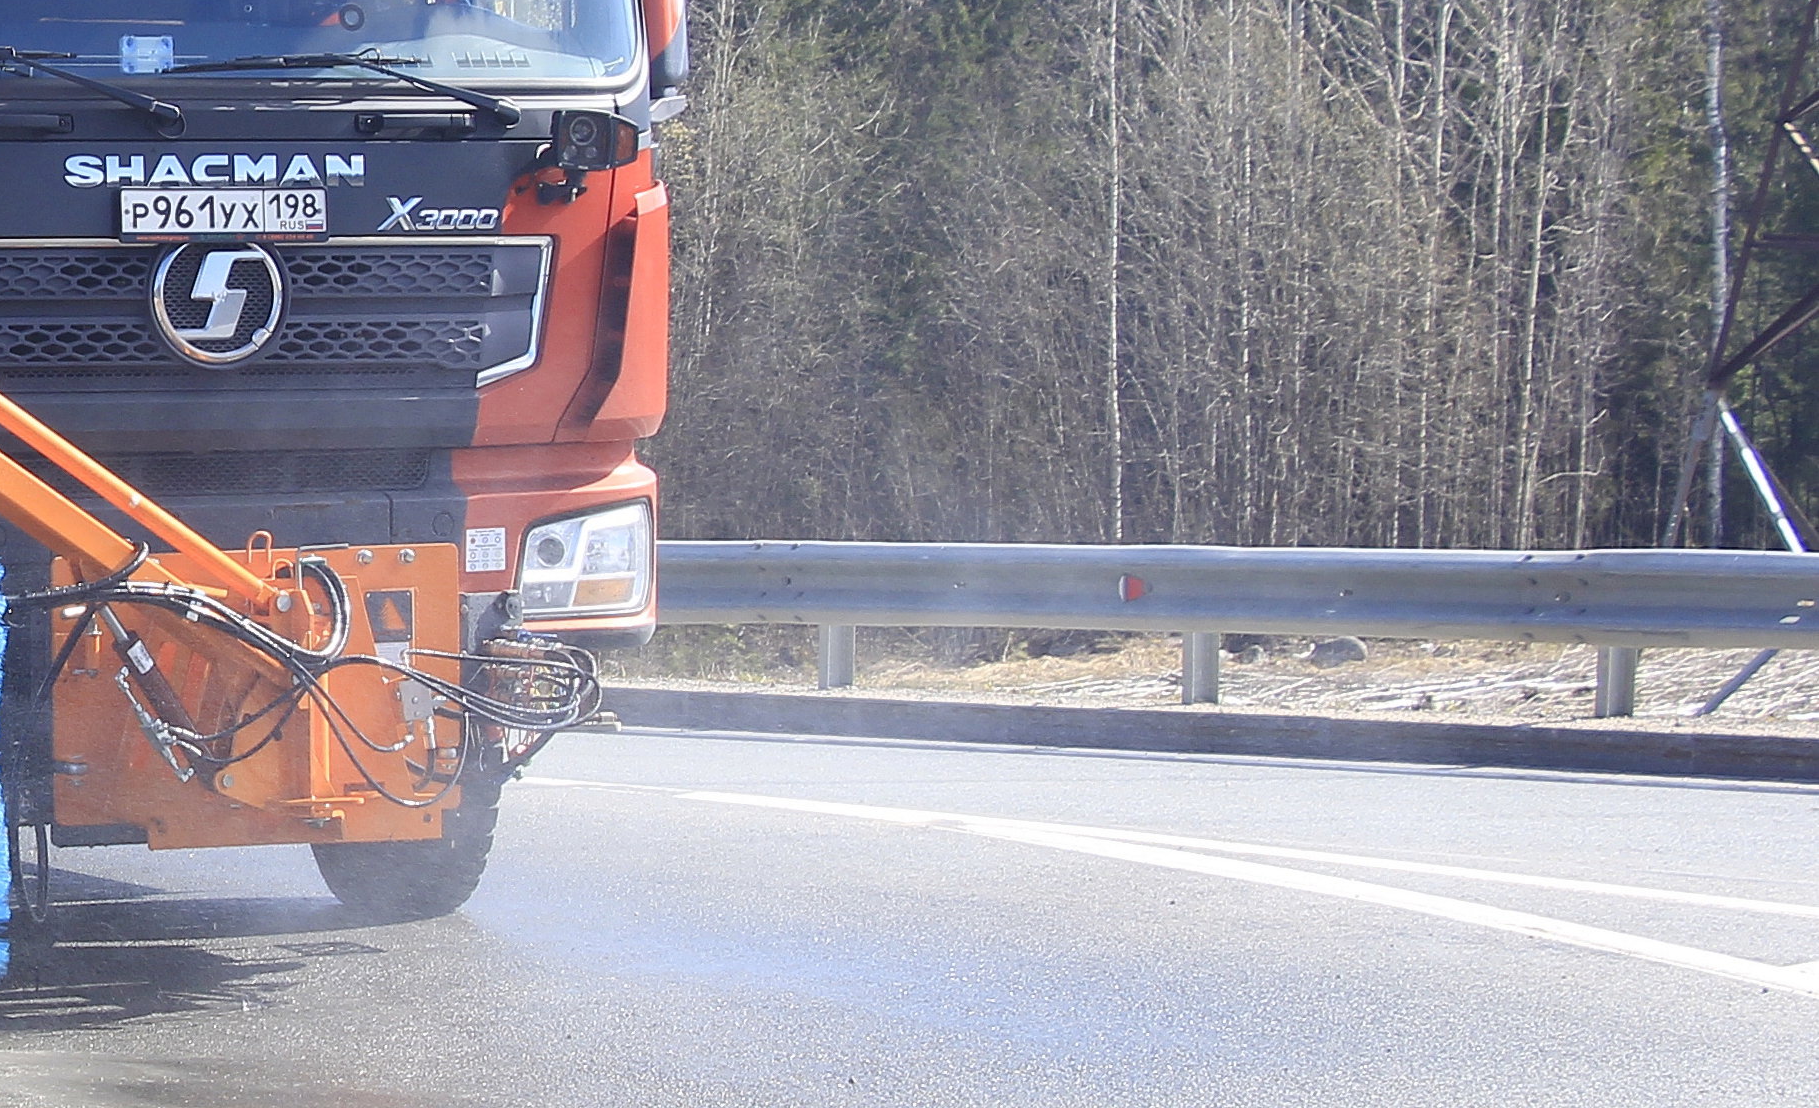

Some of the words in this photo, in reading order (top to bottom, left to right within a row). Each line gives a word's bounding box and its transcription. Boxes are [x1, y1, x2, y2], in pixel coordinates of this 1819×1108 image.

[64, 154, 365, 188] SHACMAN
[268, 193, 317, 219] 198
[377, 196, 499, 232] X3000
[281, 220, 304, 230] RUS
